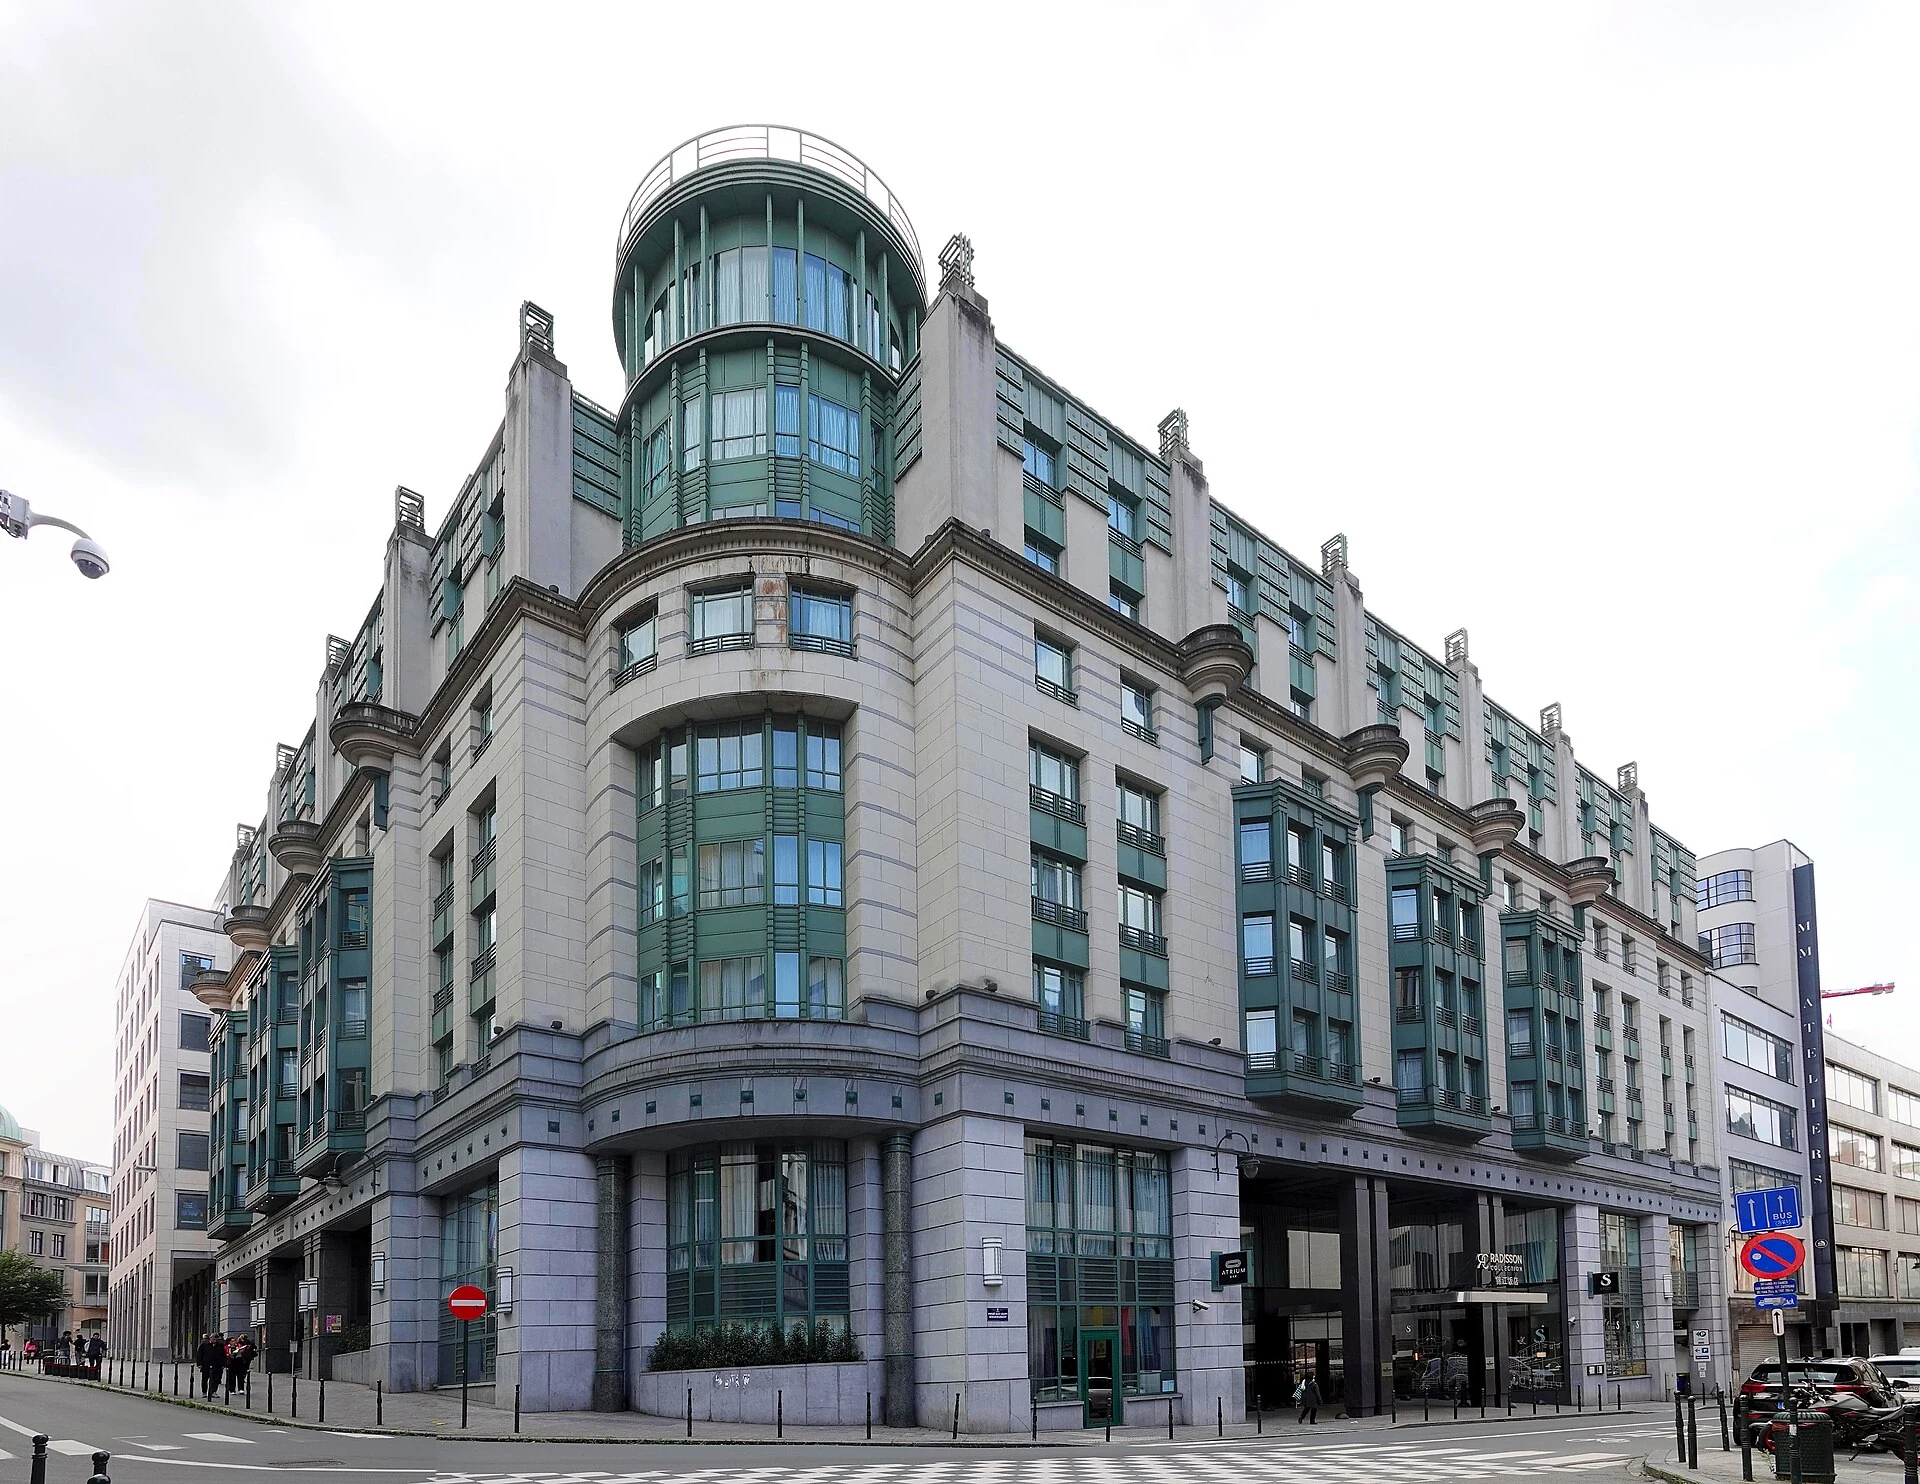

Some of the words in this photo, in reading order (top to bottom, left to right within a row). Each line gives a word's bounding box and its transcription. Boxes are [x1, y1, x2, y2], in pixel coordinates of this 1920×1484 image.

[1803, 998, 1824, 1184] ATELIERS
[1772, 1211, 1793, 1221] BUS
[1490, 1253, 1523, 1265] RADISSON
[1222, 1268, 1246, 1276] ATRIUM
[1600, 1273, 1612, 1287] S
